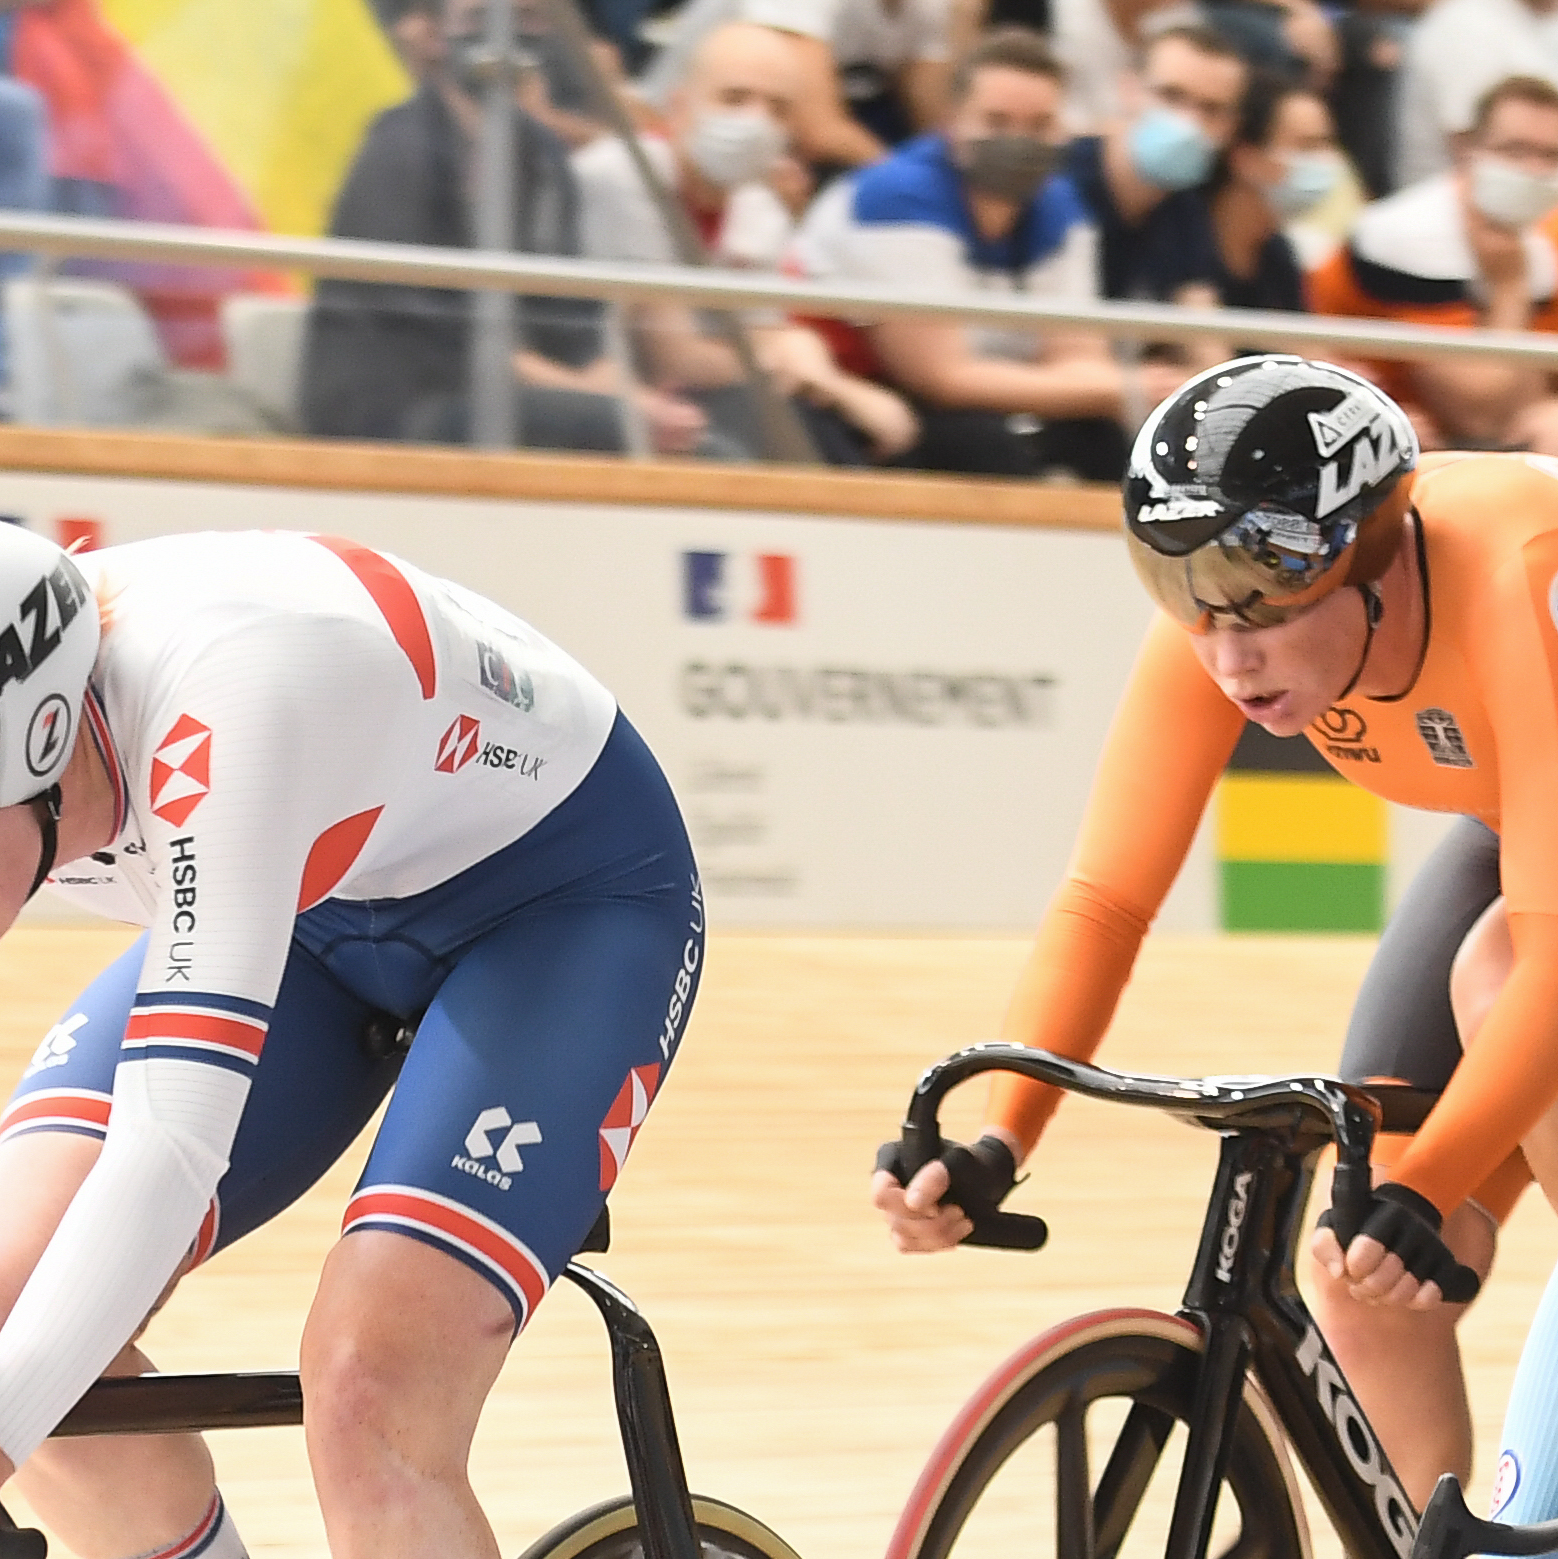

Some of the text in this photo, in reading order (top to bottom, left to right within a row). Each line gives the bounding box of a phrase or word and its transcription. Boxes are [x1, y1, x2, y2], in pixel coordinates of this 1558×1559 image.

[165, 836, 197, 982] HSBC UK
[659, 939, 699, 1060] HSBC
[1215, 1171, 1253, 1284] KOGA
